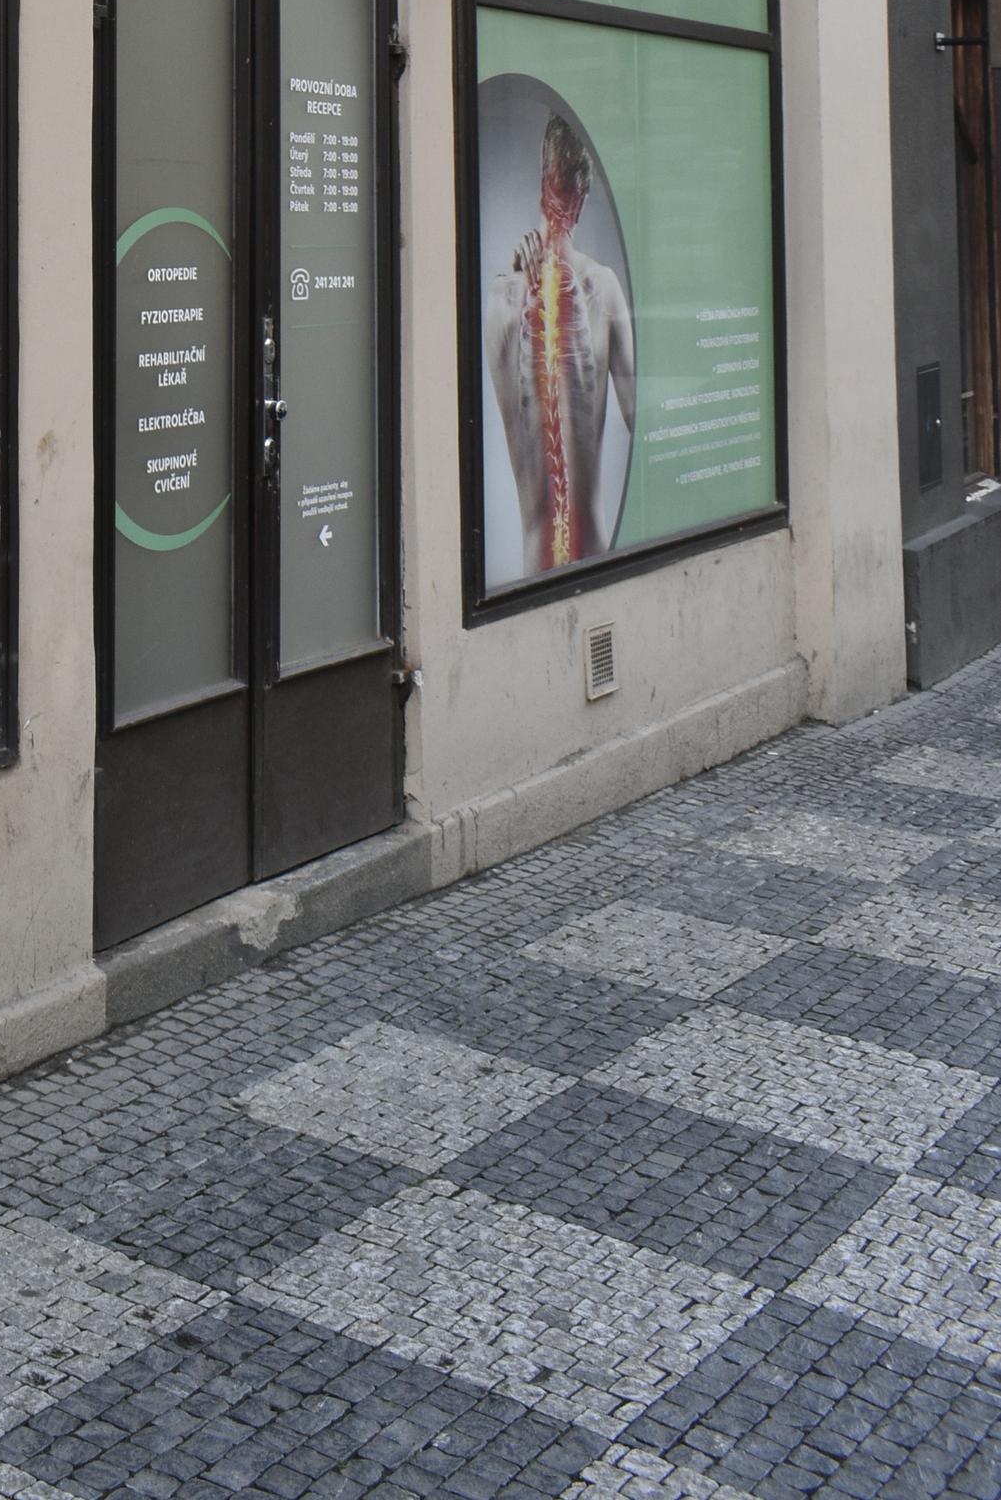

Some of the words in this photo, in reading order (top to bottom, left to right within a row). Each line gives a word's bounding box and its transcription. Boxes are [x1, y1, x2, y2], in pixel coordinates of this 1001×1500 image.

[290, 77, 334, 96] PROVOZNÍ
[334, 83, 358, 98] DOBA
[307, 100, 342, 116] RECEPCE
[147, 266, 198, 282] ORTOPEDIE
[314, 276, 327, 288] 241
[328, 276, 341, 288] 241
[342, 275, 355, 288] 241
[140, 307, 204, 325] FYZIOTERAPIE
[138, 345, 206, 368] REHABILITAČNÍ
[157, 366, 187, 387] LÉKAŘ
[138, 407, 205, 432] ELEKTROLÉČBA
[146, 452, 198, 474] SKUPINOVÉ
[154, 470, 190, 494] CVIČENÍ
